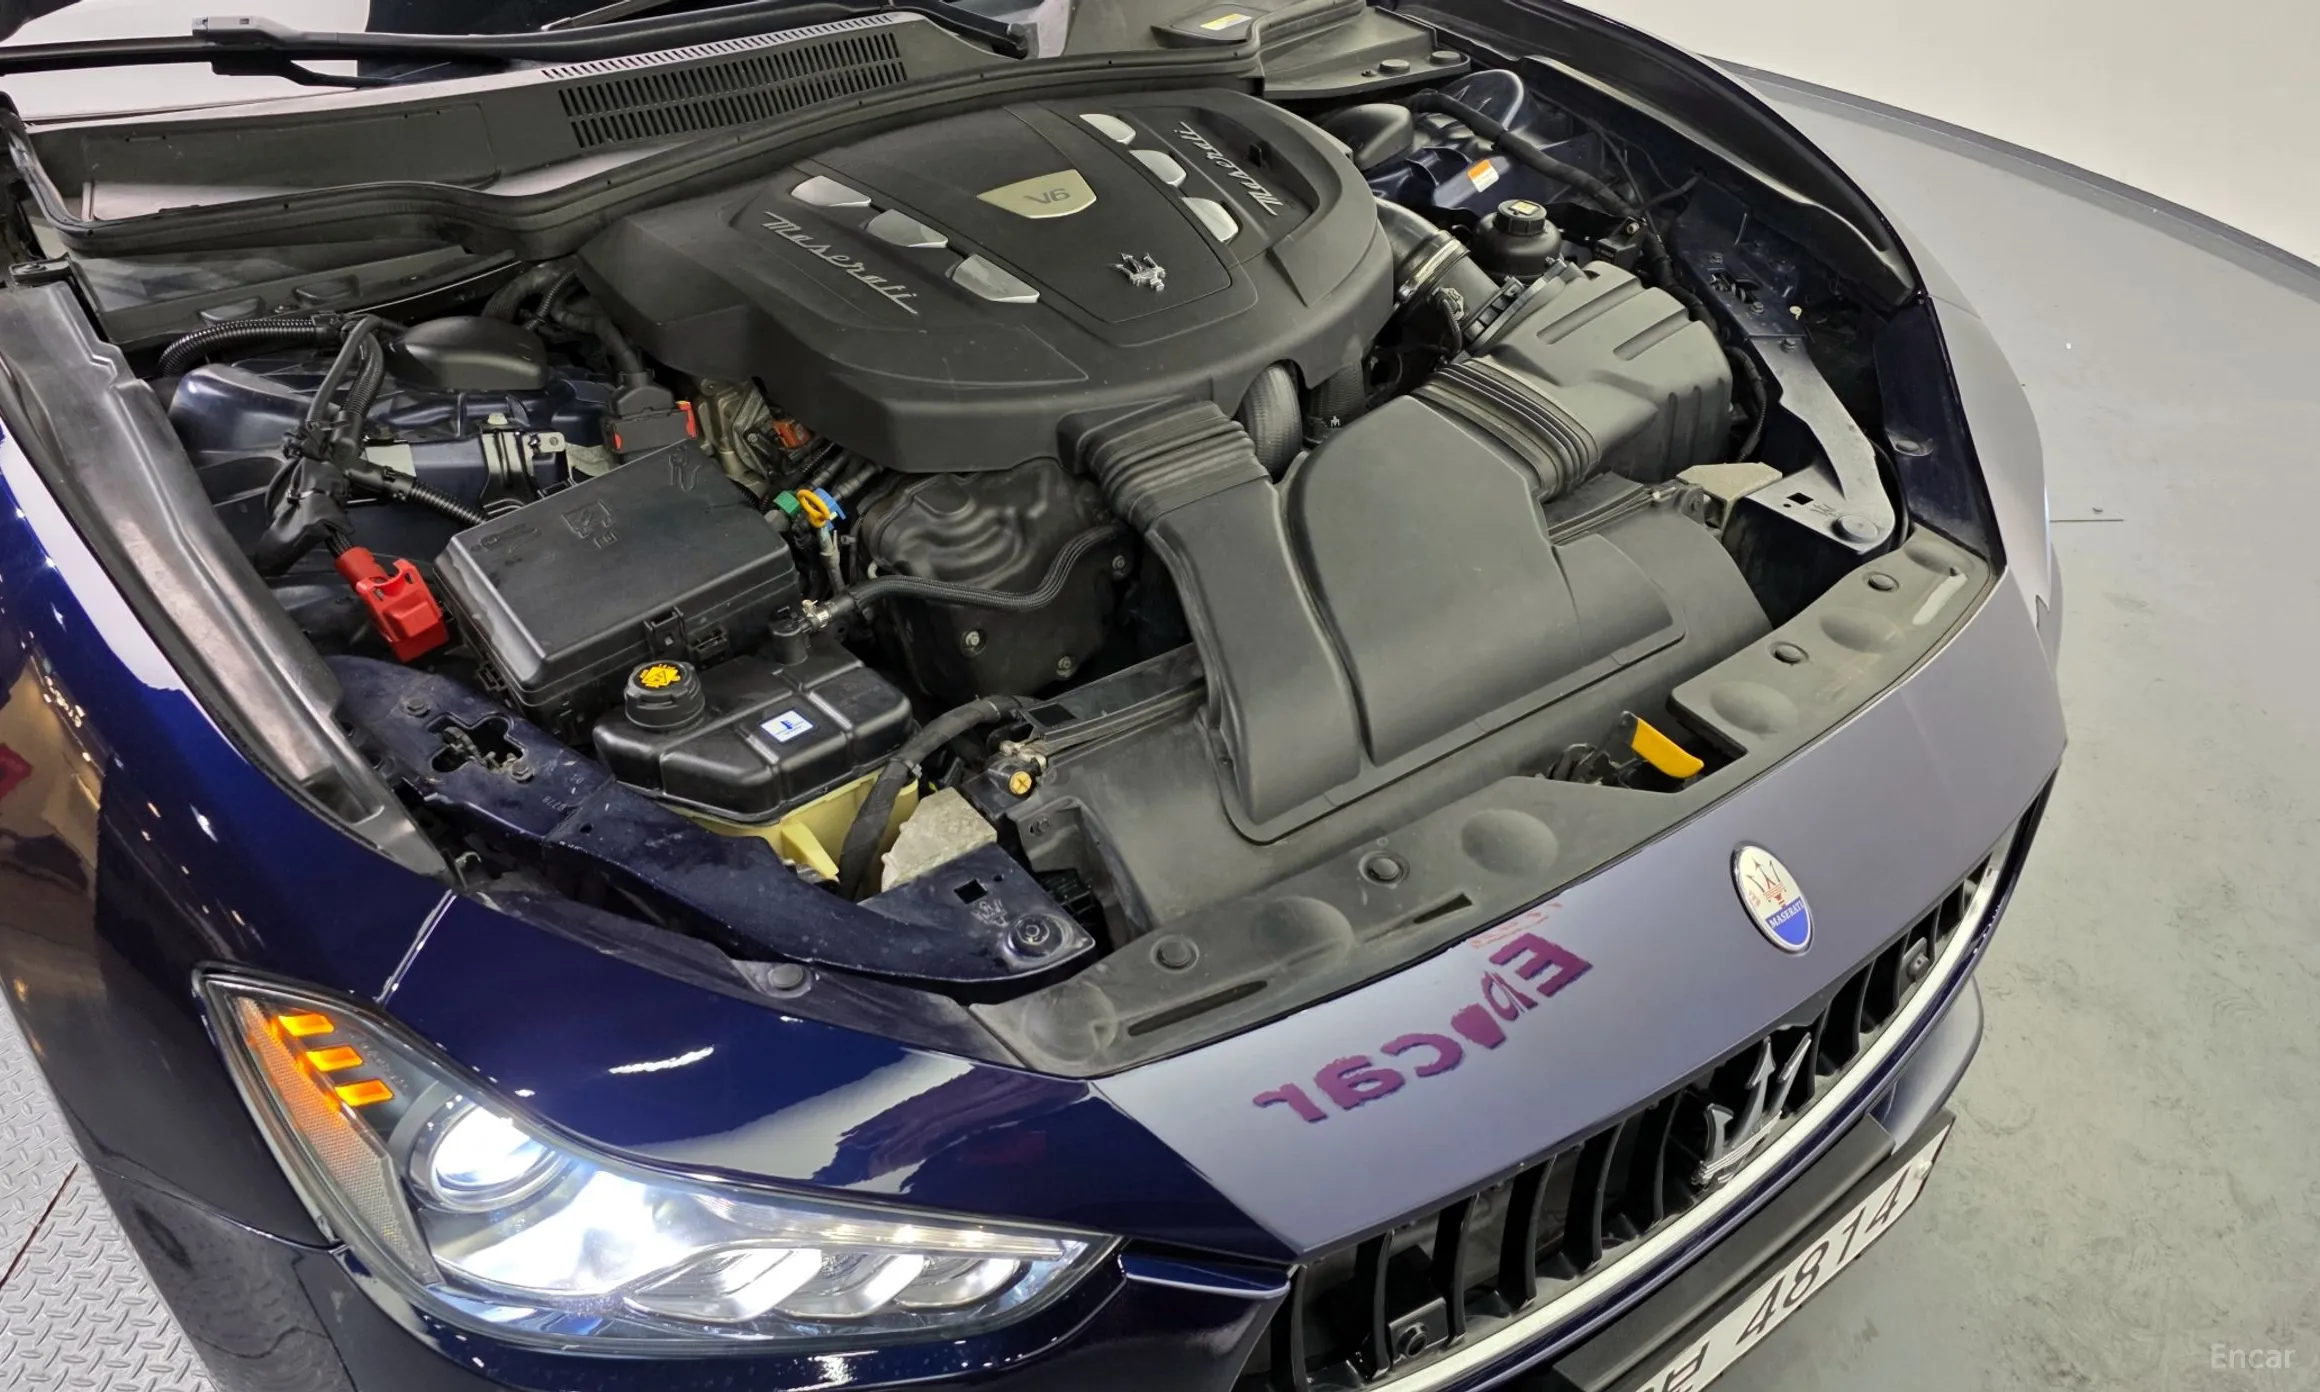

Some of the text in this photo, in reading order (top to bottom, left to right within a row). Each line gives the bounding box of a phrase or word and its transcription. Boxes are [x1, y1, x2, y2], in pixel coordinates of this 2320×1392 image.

[1024, 187, 1070, 205] V6
[762, 210, 918, 315] Maserati
[1769, 901, 1804, 928] MASERATI
[1736, 1166, 1910, 1346] 4814
